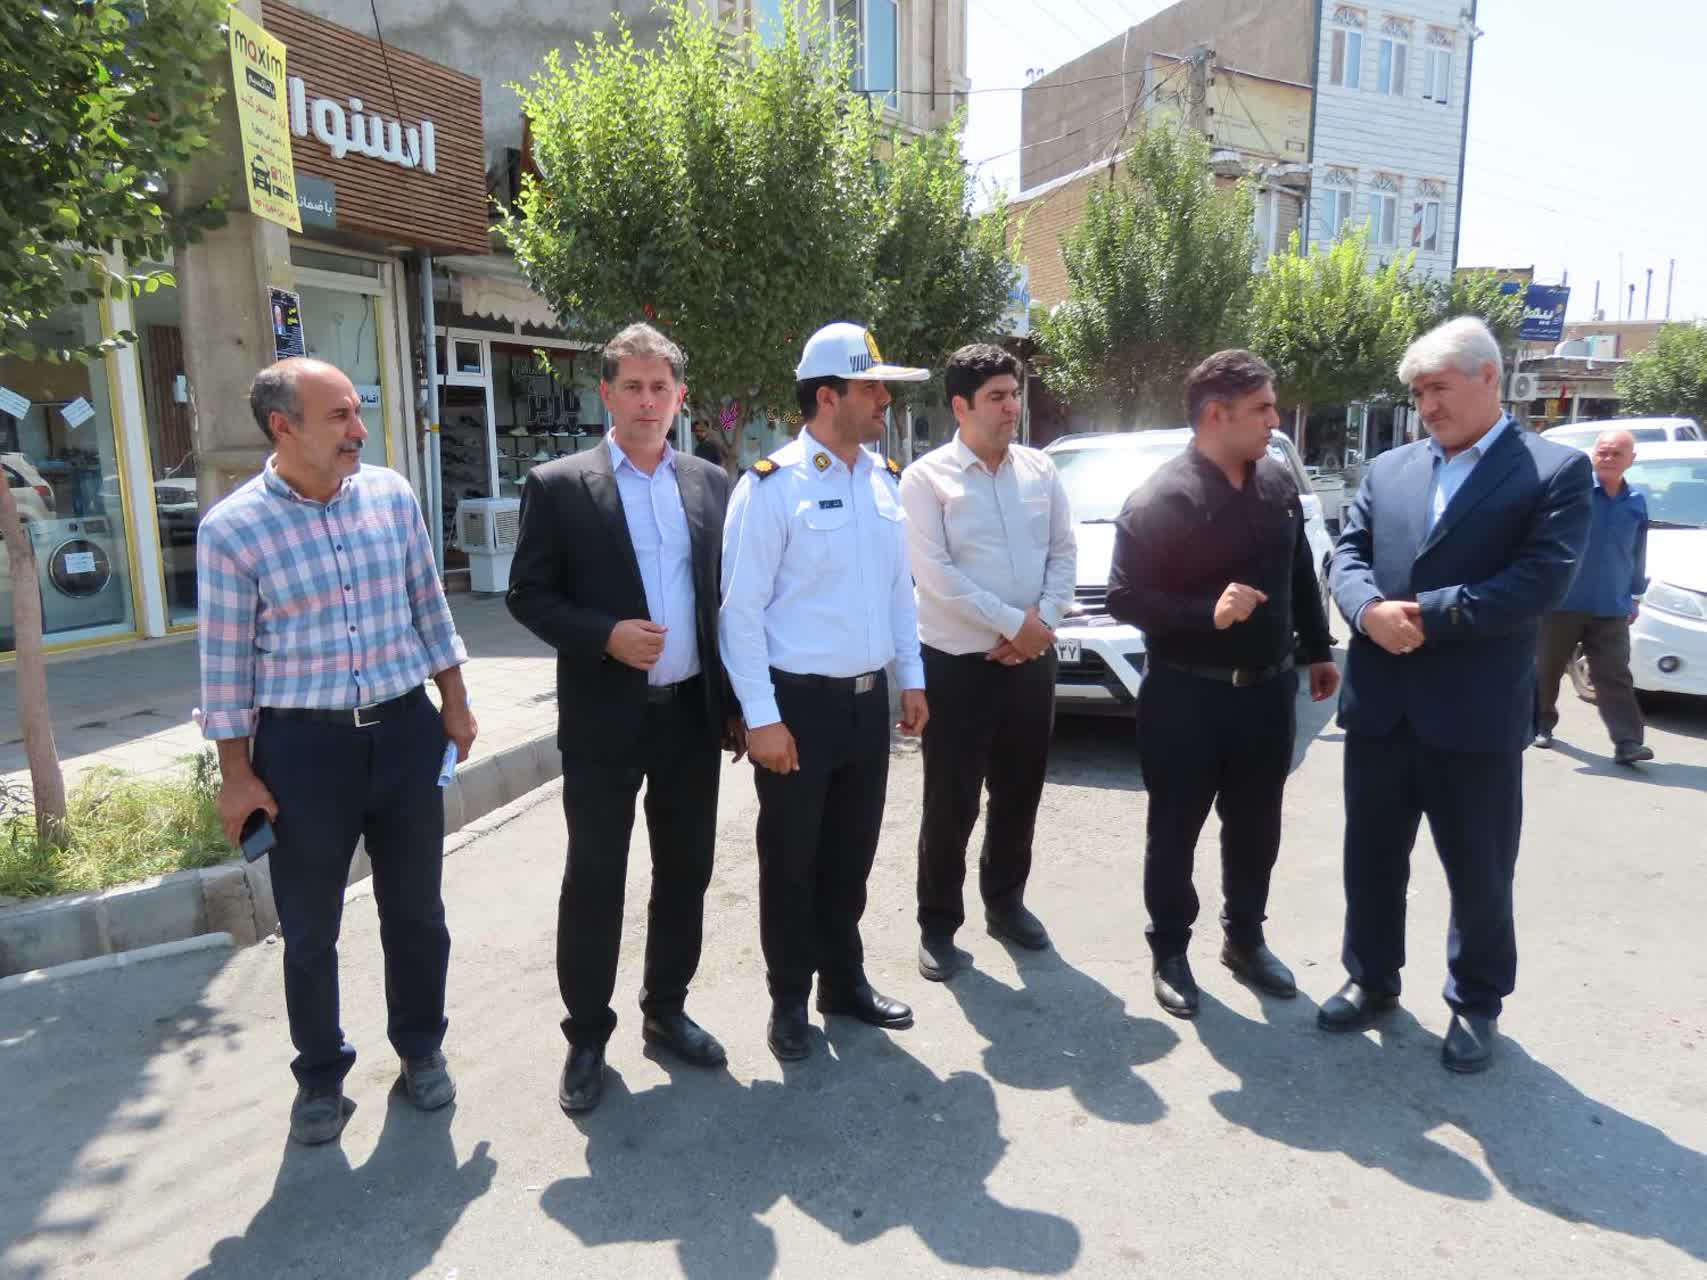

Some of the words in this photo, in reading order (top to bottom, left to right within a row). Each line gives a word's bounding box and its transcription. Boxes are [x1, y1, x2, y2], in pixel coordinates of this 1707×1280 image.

[234, 29, 283, 80] maxim
[288, 76, 436, 174] اسنوا
[297, 195, 324, 212] ضمان
